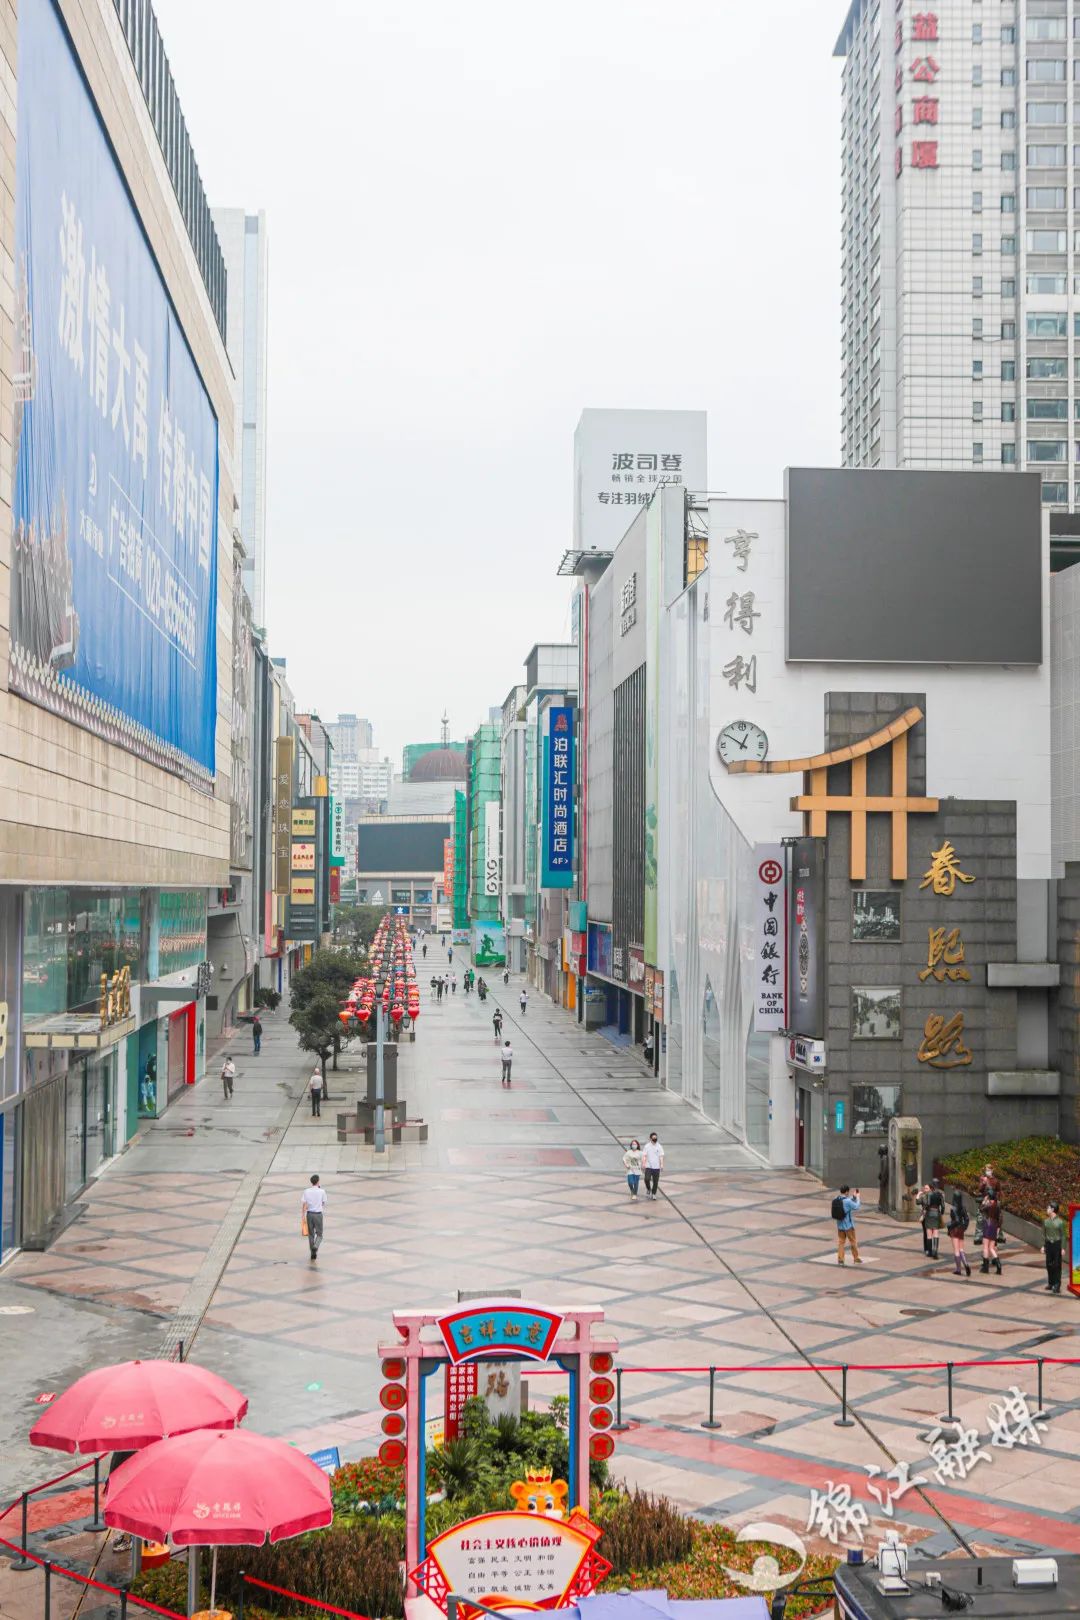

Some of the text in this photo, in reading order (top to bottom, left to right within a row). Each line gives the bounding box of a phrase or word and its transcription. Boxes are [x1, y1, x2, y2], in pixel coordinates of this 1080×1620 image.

[611, 453, 683, 471] 波司登
[722, 529, 761, 695] 亨得利
[552, 736, 569, 853] 泊联汇时尚酒店
[552, 857, 565, 865] 4F
[486, 859, 498, 893] GXG
[917, 840, 977, 1069] 春熙路
[458, 1318, 543, 1345] 吉祥如意
[460, 1536, 562, 1551] 社会主义核心价值观
[490, 1555, 509, 1564] 民主
[514, 1554, 532, 1563] 文明
[468, 1571, 486, 1580] 自由
[513, 1569, 532, 1578] 公正
